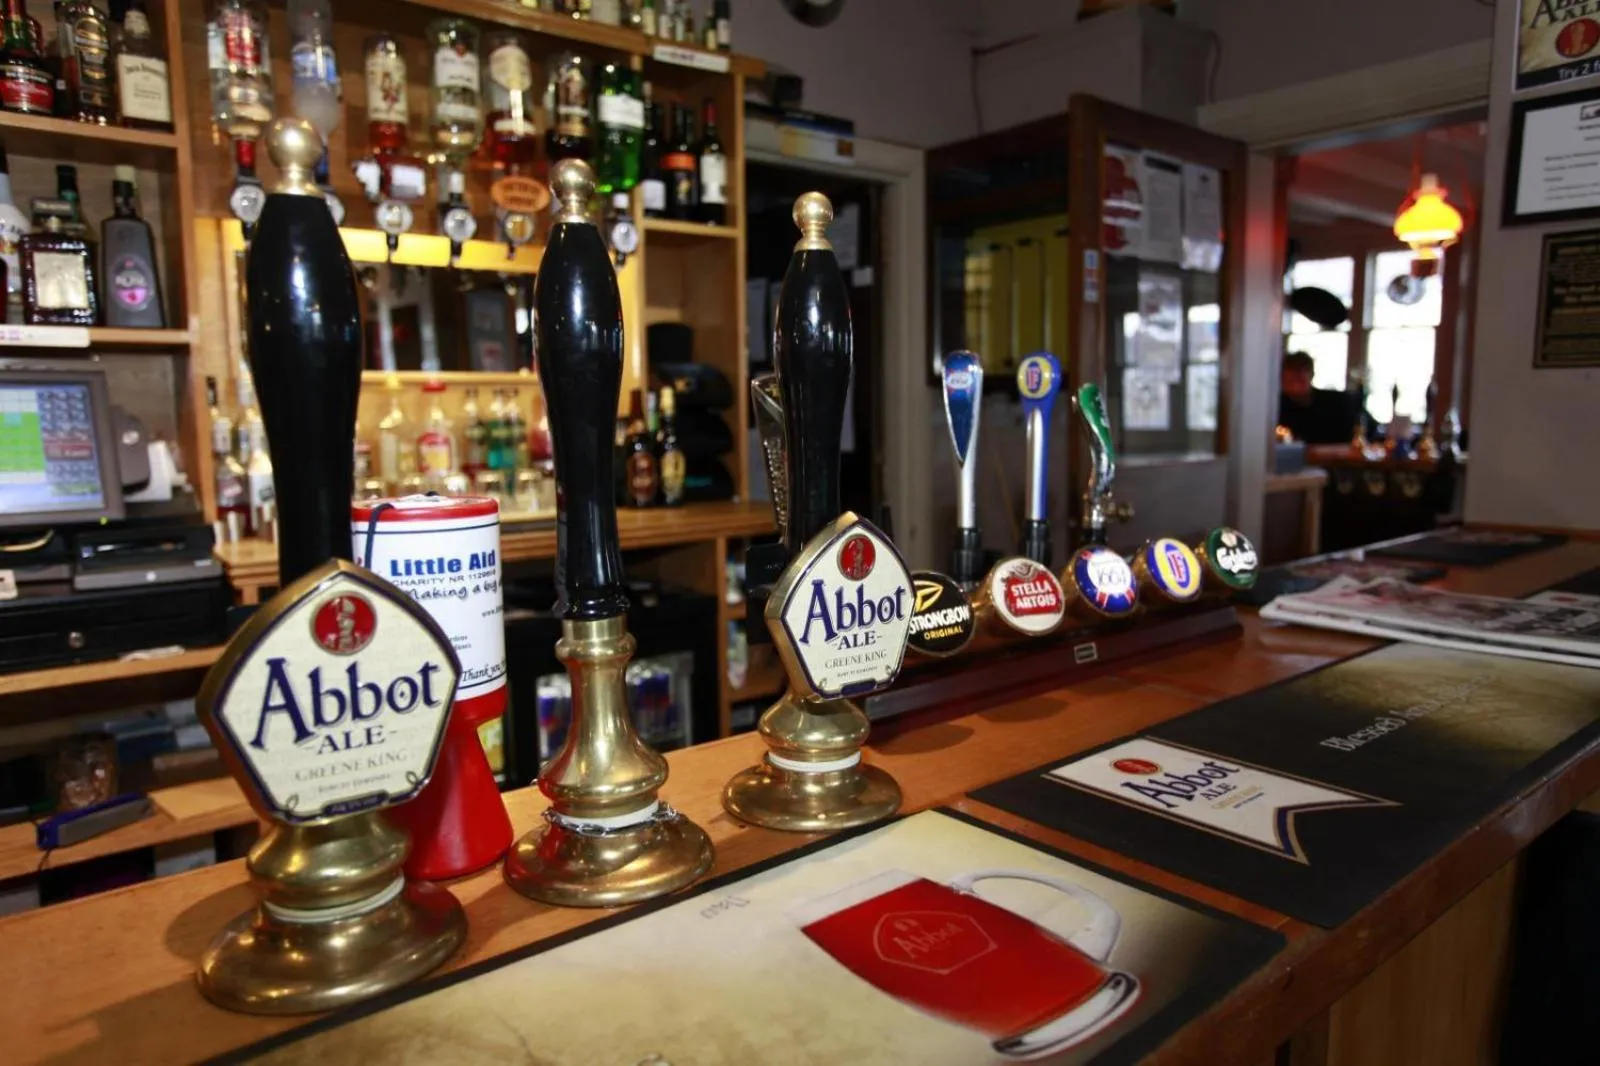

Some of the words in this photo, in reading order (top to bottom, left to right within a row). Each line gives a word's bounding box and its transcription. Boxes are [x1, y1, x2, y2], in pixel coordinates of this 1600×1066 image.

[1582, 63, 1591, 76] 2
[390, 556, 462, 577] Little
[468, 549, 496, 571] Aid
[392, 576, 445, 587] CHARITY
[449, 575, 465, 583] NR
[1011, 580, 1053, 597] STELLA
[1016, 593, 1057, 609] ARTOIS
[799, 579, 906, 645] Abbot
[909, 604, 971, 635] STRONGBOW
[924, 626, 963, 640] ORIGINAL
[825, 653, 862, 669] GREENE
[865, 649, 887, 662] KING
[463, 664, 489, 682] Thank
[249, 657, 441, 751] Abbot
[294, 760, 362, 782] GREENE
[366, 749, 409, 769] KING
[1120, 761, 1240, 809] Abbot
[1200, 782, 1238, 801] ALE
